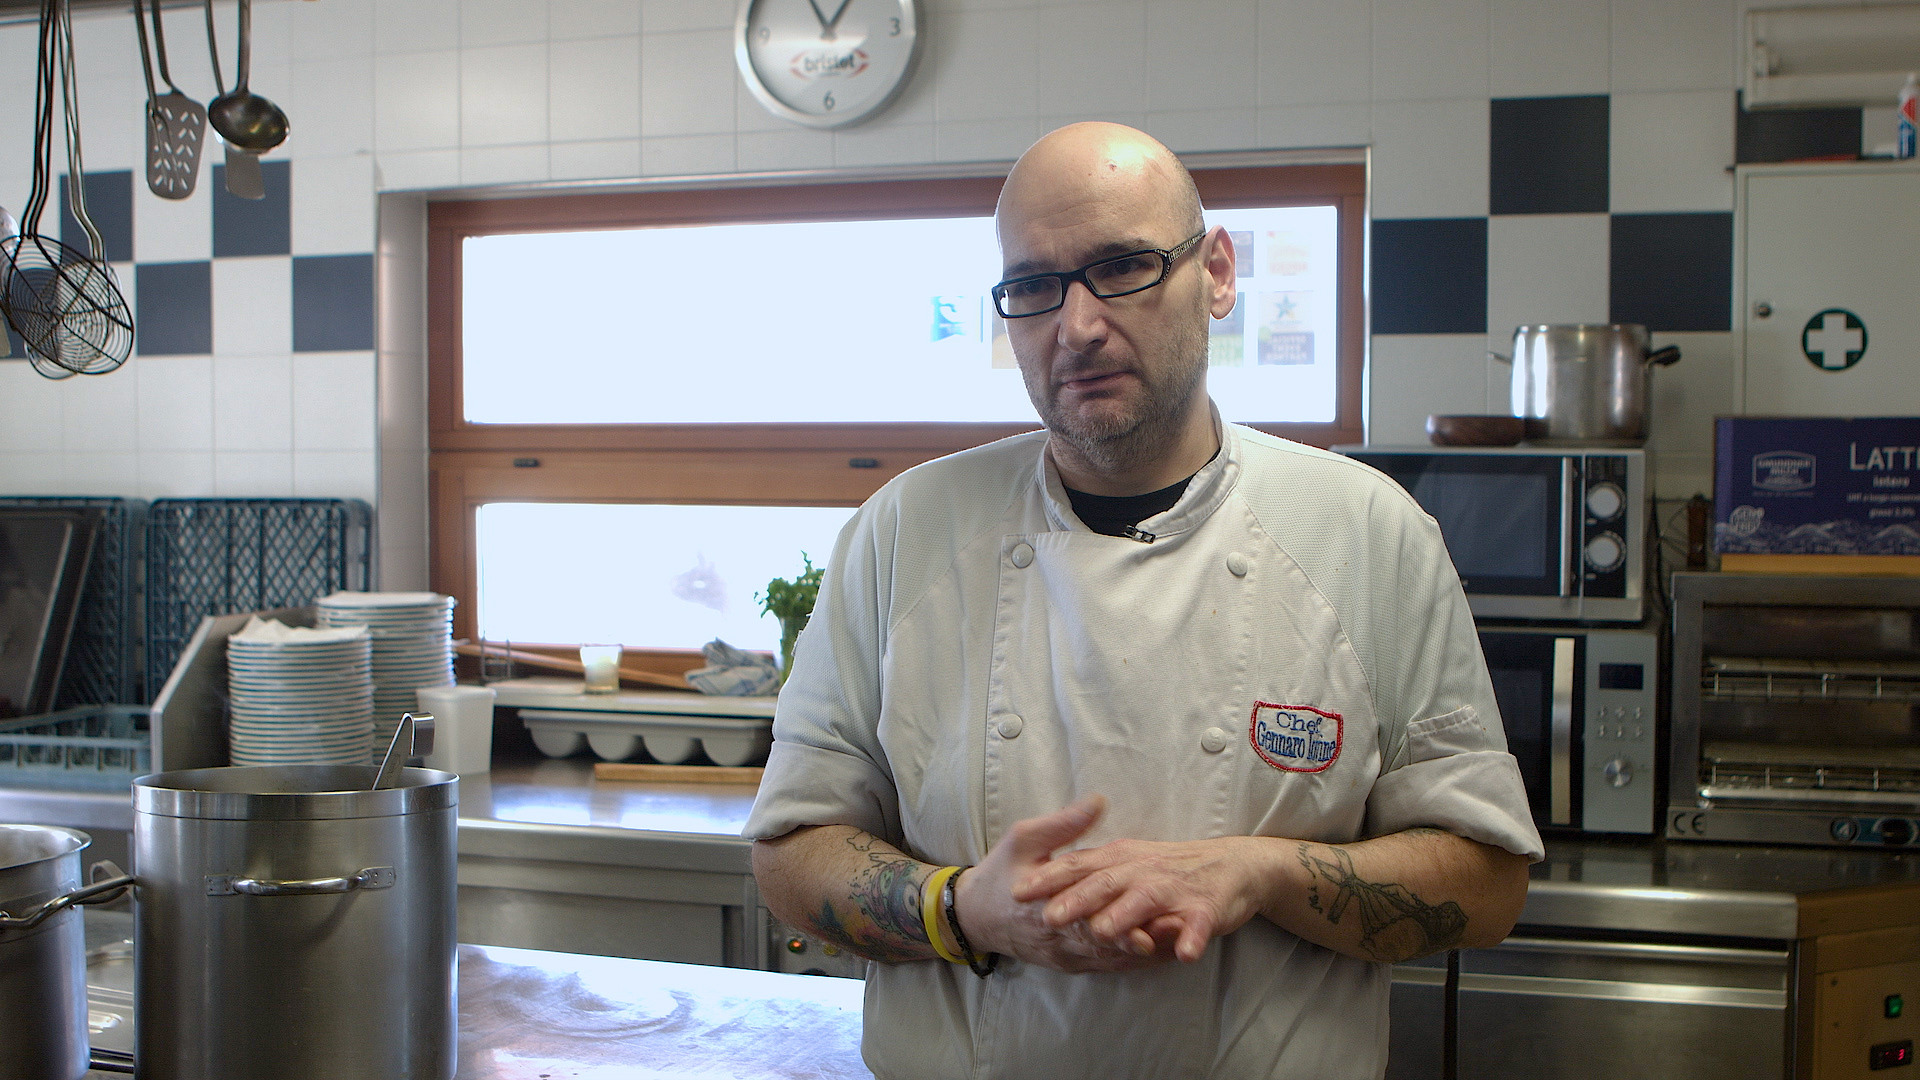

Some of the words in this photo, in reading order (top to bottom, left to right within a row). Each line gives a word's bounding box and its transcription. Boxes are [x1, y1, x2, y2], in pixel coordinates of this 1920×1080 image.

[759, 27, 771, 45] 9
[889, 17, 901, 36] 3
[823, 90, 836, 111] 6
[1276, 711, 1323, 734] Chef
[1257, 720, 1306, 759] Gennaro
